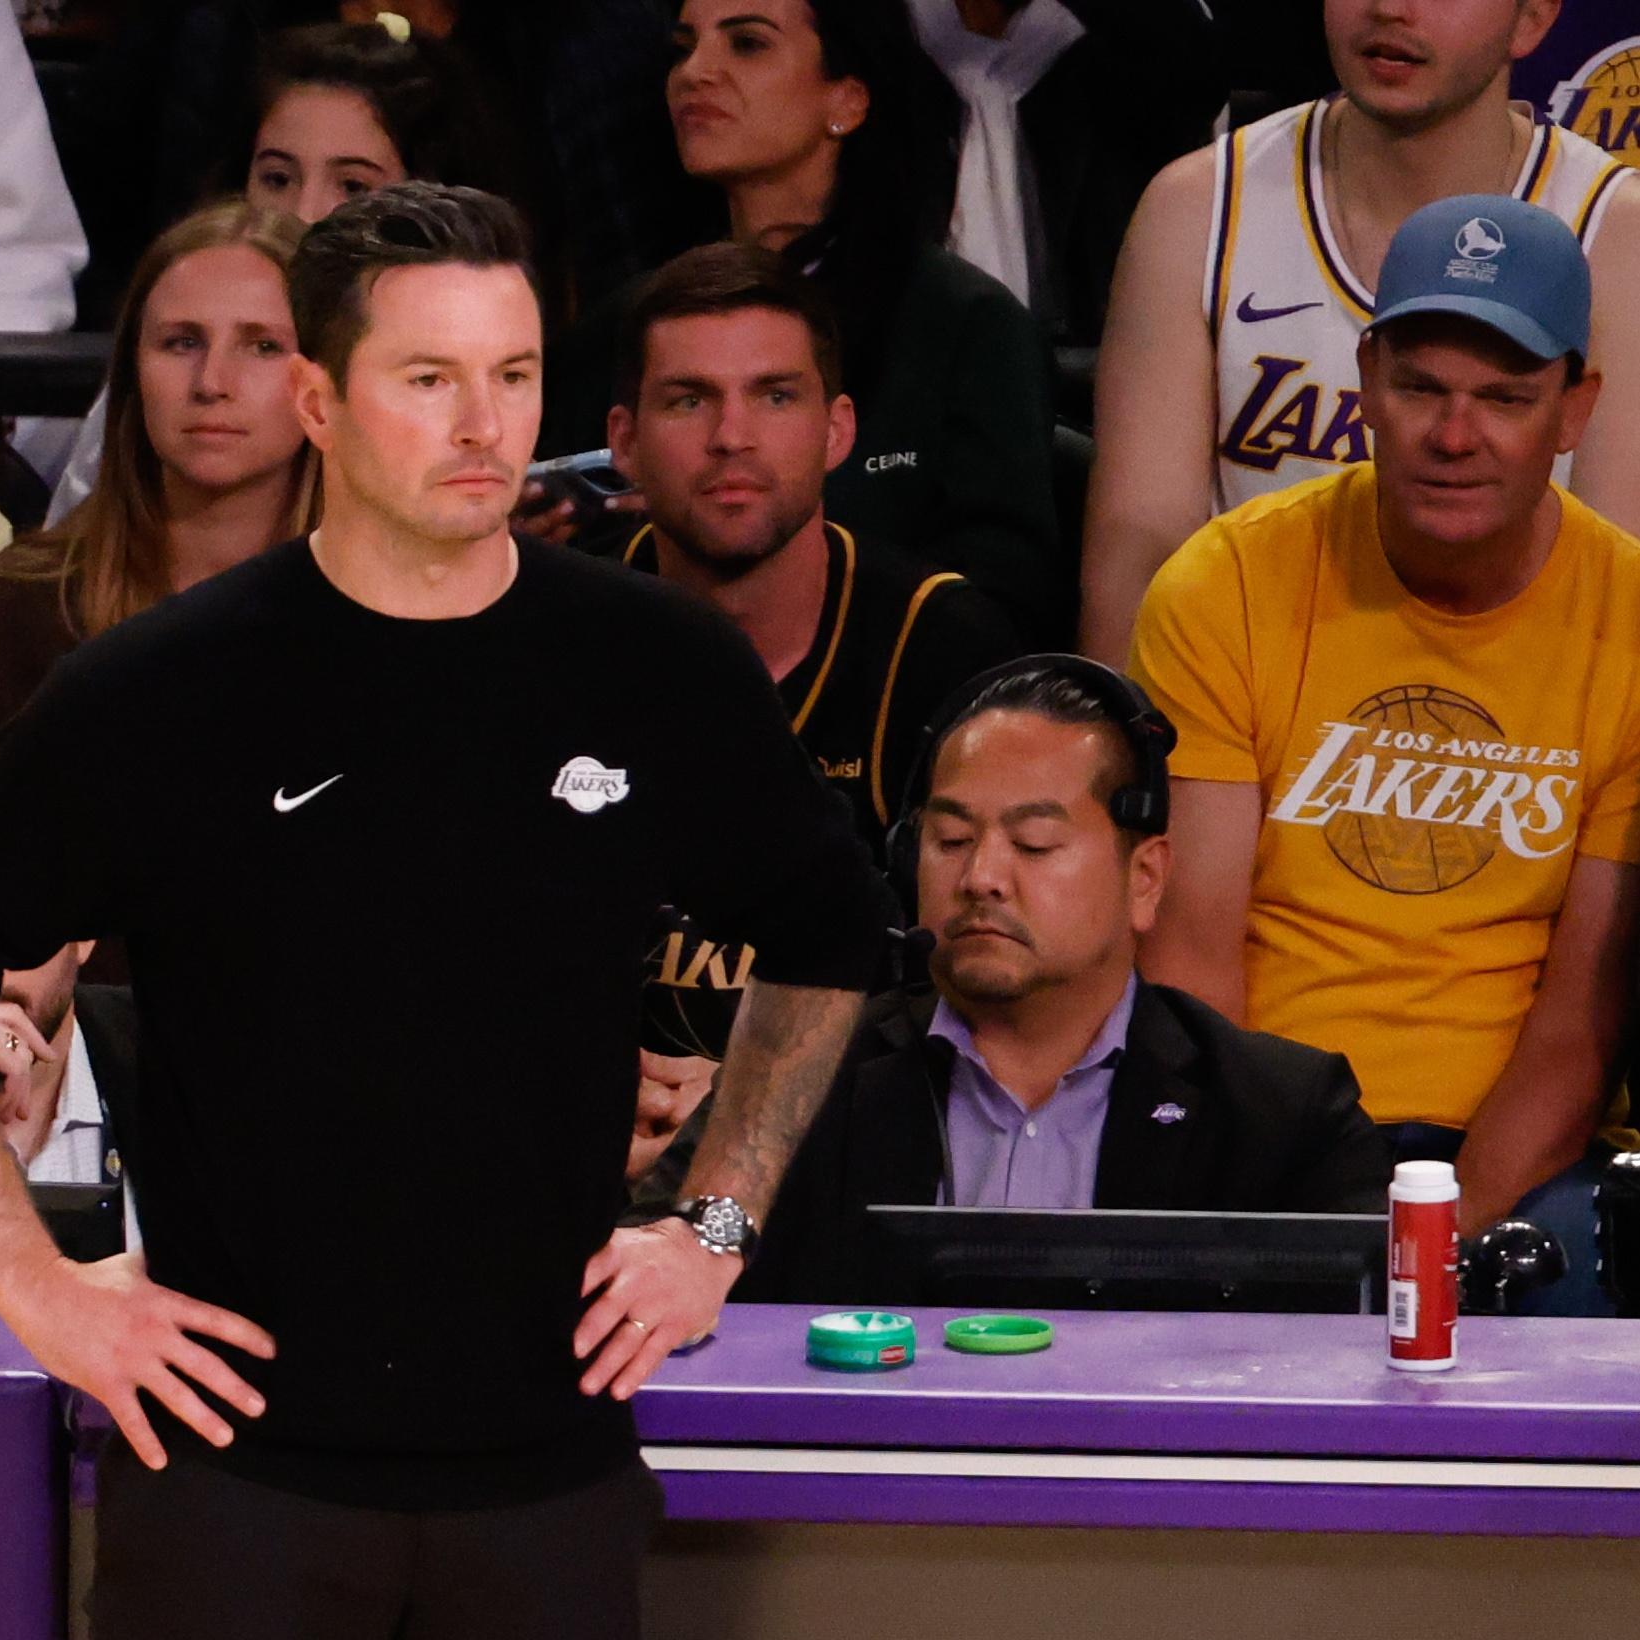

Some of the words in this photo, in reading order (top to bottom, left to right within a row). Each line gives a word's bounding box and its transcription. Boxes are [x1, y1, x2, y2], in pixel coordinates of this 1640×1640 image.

[1372, 729, 1435, 752] LOS
[1435, 738, 1581, 768] ANGELES
[558, 769, 620, 798] LAKERS
[1268, 721, 1576, 859] LAKERS
